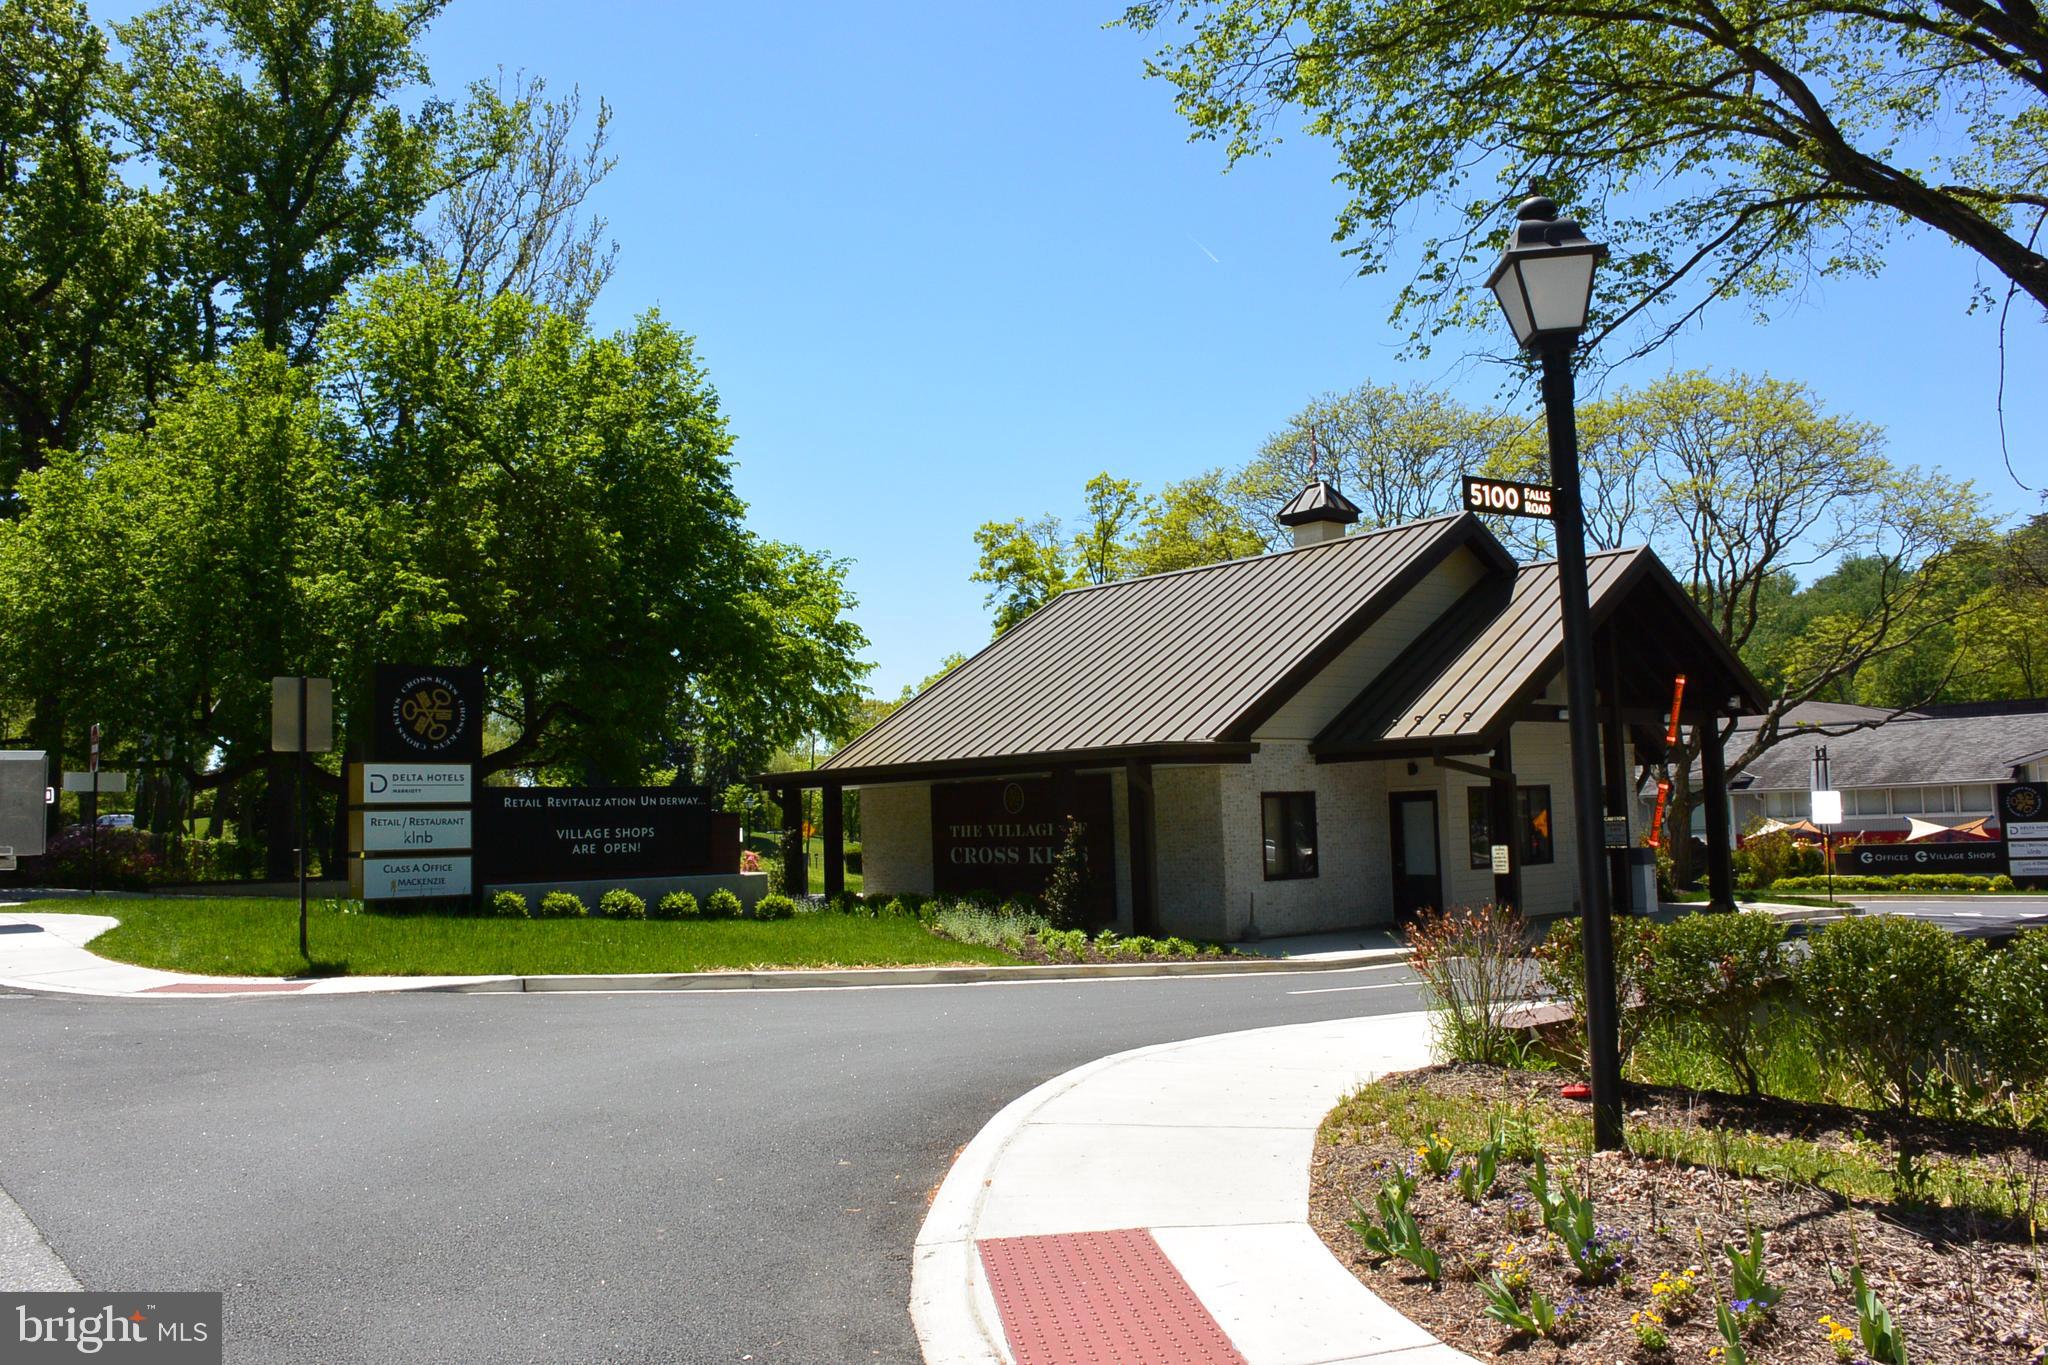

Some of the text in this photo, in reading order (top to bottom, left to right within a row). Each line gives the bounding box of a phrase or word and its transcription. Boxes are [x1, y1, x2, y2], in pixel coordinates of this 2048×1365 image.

[1470, 483, 1519, 510] 5100
[1524, 488, 1551, 502] FALLS
[1524, 501, 1551, 515] ROAD
[401, 676, 458, 696] CROSS KEYS
[392, 774, 464, 782] DELTA HOTELS
[504, 797, 542, 808] RETAIL
[370, 818, 400, 826] RETAIL
[409, 817, 464, 826] RESTAURANT
[404, 831, 433, 844] klnb
[556, 827, 655, 840] VILLAGE SHOPS
[950, 824, 982, 838] THE
[572, 842, 641, 855] ARE OPEN!
[950, 846, 1089, 864] CROSS KES
[1874, 851, 1996, 861] OFFICES VILLAGE SHOPS
[383, 863, 453, 873] CLASS A OFFICE
[398, 877, 447, 886] MACKENZIE
